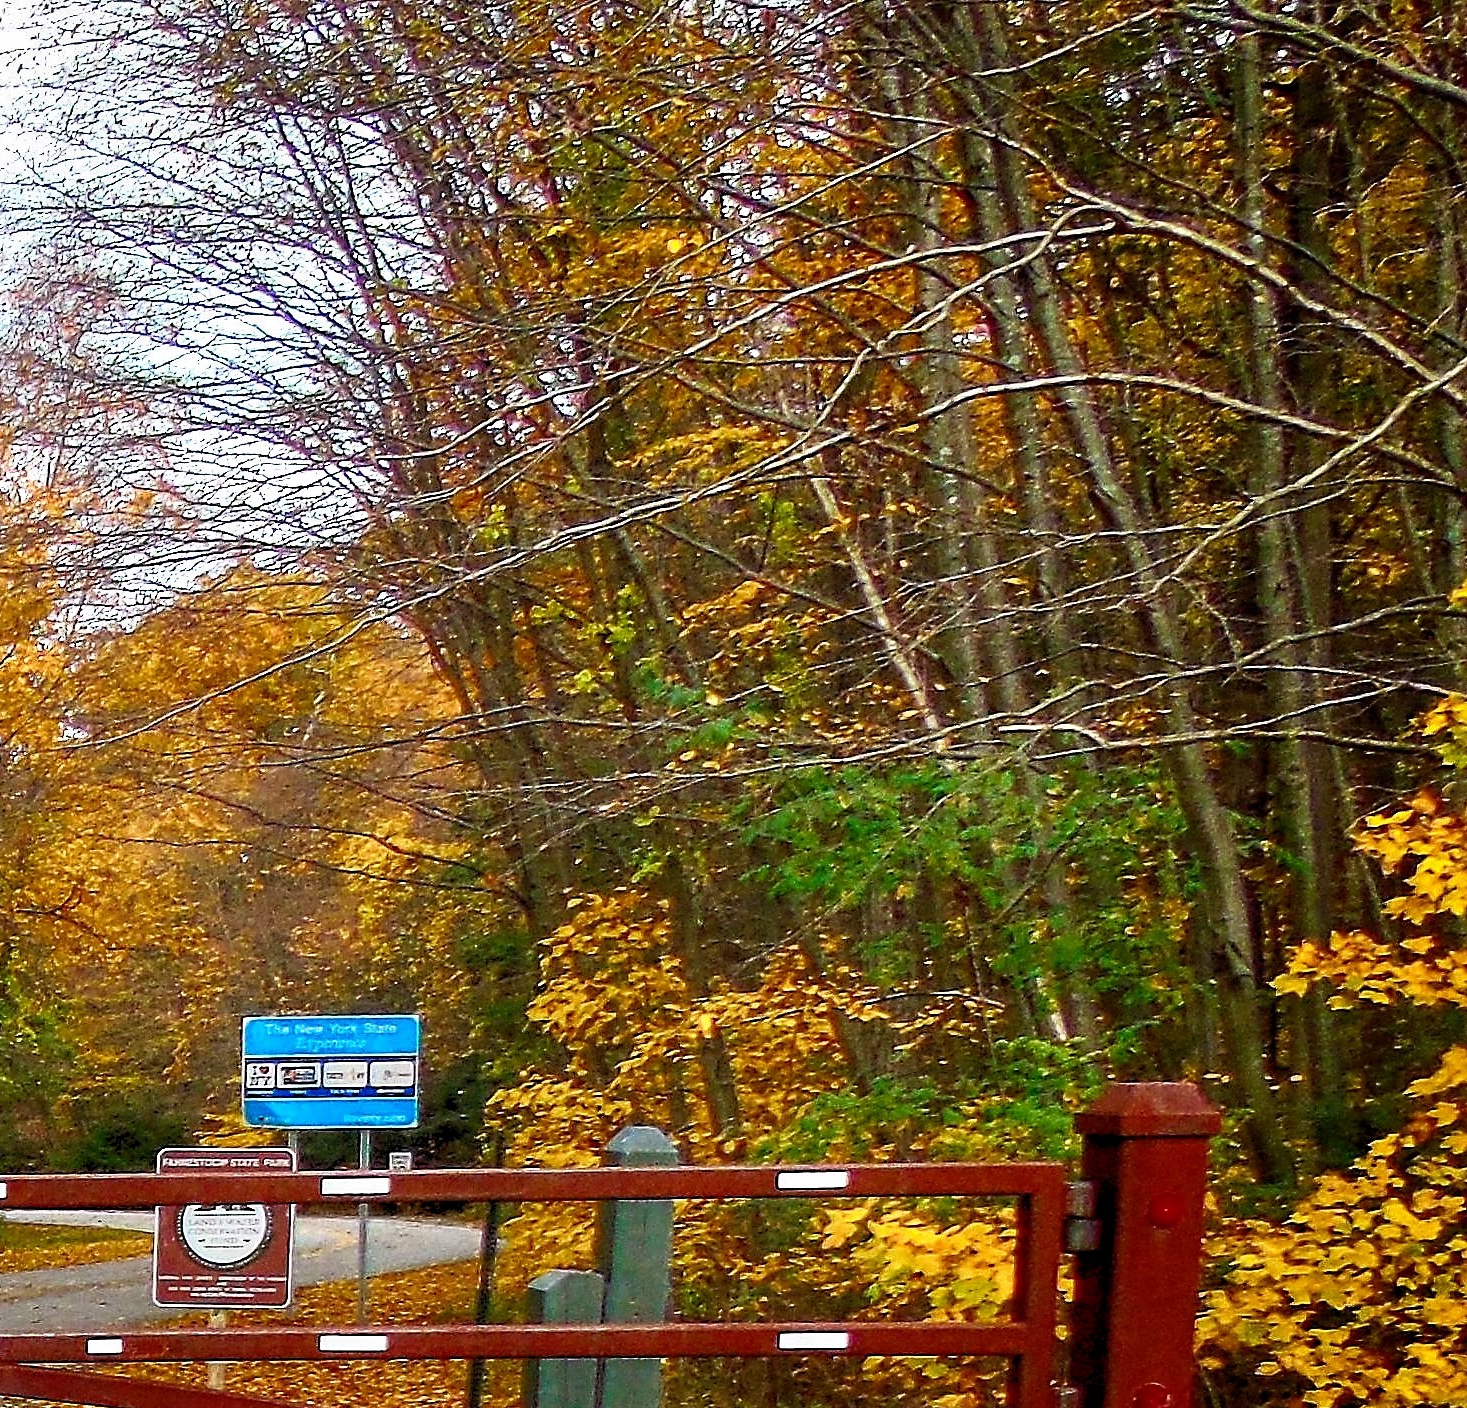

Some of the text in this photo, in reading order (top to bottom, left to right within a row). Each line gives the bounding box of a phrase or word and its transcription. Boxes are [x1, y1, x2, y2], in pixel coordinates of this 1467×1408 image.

[264, 1022, 398, 1035] The New York State
[230, 1158, 260, 1168] STATE
[263, 1158, 291, 1168] PARK
